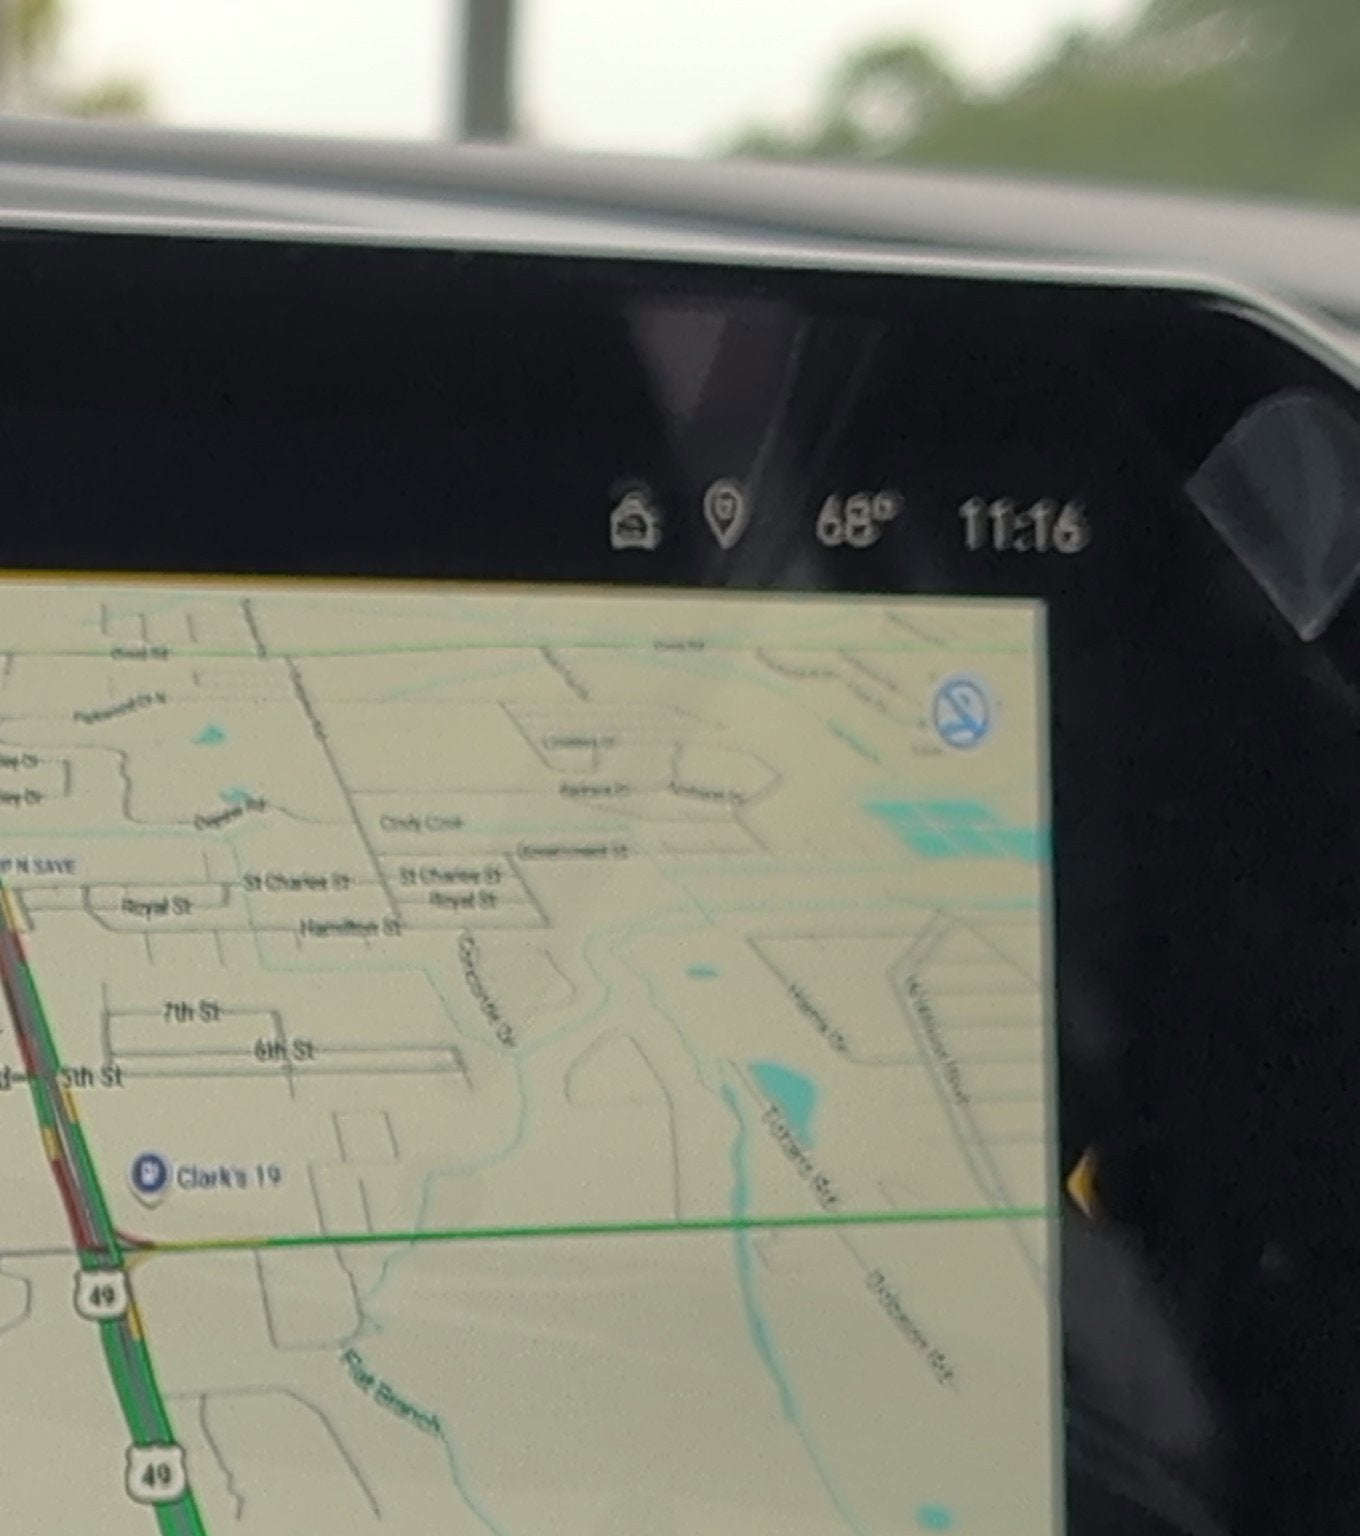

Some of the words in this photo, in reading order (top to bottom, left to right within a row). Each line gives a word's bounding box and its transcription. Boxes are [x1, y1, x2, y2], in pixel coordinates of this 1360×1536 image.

[817, 489, 903, 547] 68°
[959, 496, 1091, 553] 11:16
[34, 858, 76, 875] SAVE
[163, 1001, 194, 1023] 7th
[197, 1001, 221, 1022] St
[253, 1038, 287, 1062] 6th
[291, 1039, 316, 1060] St
[60, 1066, 96, 1088] 5th
[98, 1066, 124, 1087] St
[177, 1165, 249, 1191] Clark's
[255, 1166, 283, 1187] 19
[89, 1284, 116, 1306] 49
[375, 1381, 441, 1435] Branch
[141, 1460, 172, 1487] 49
